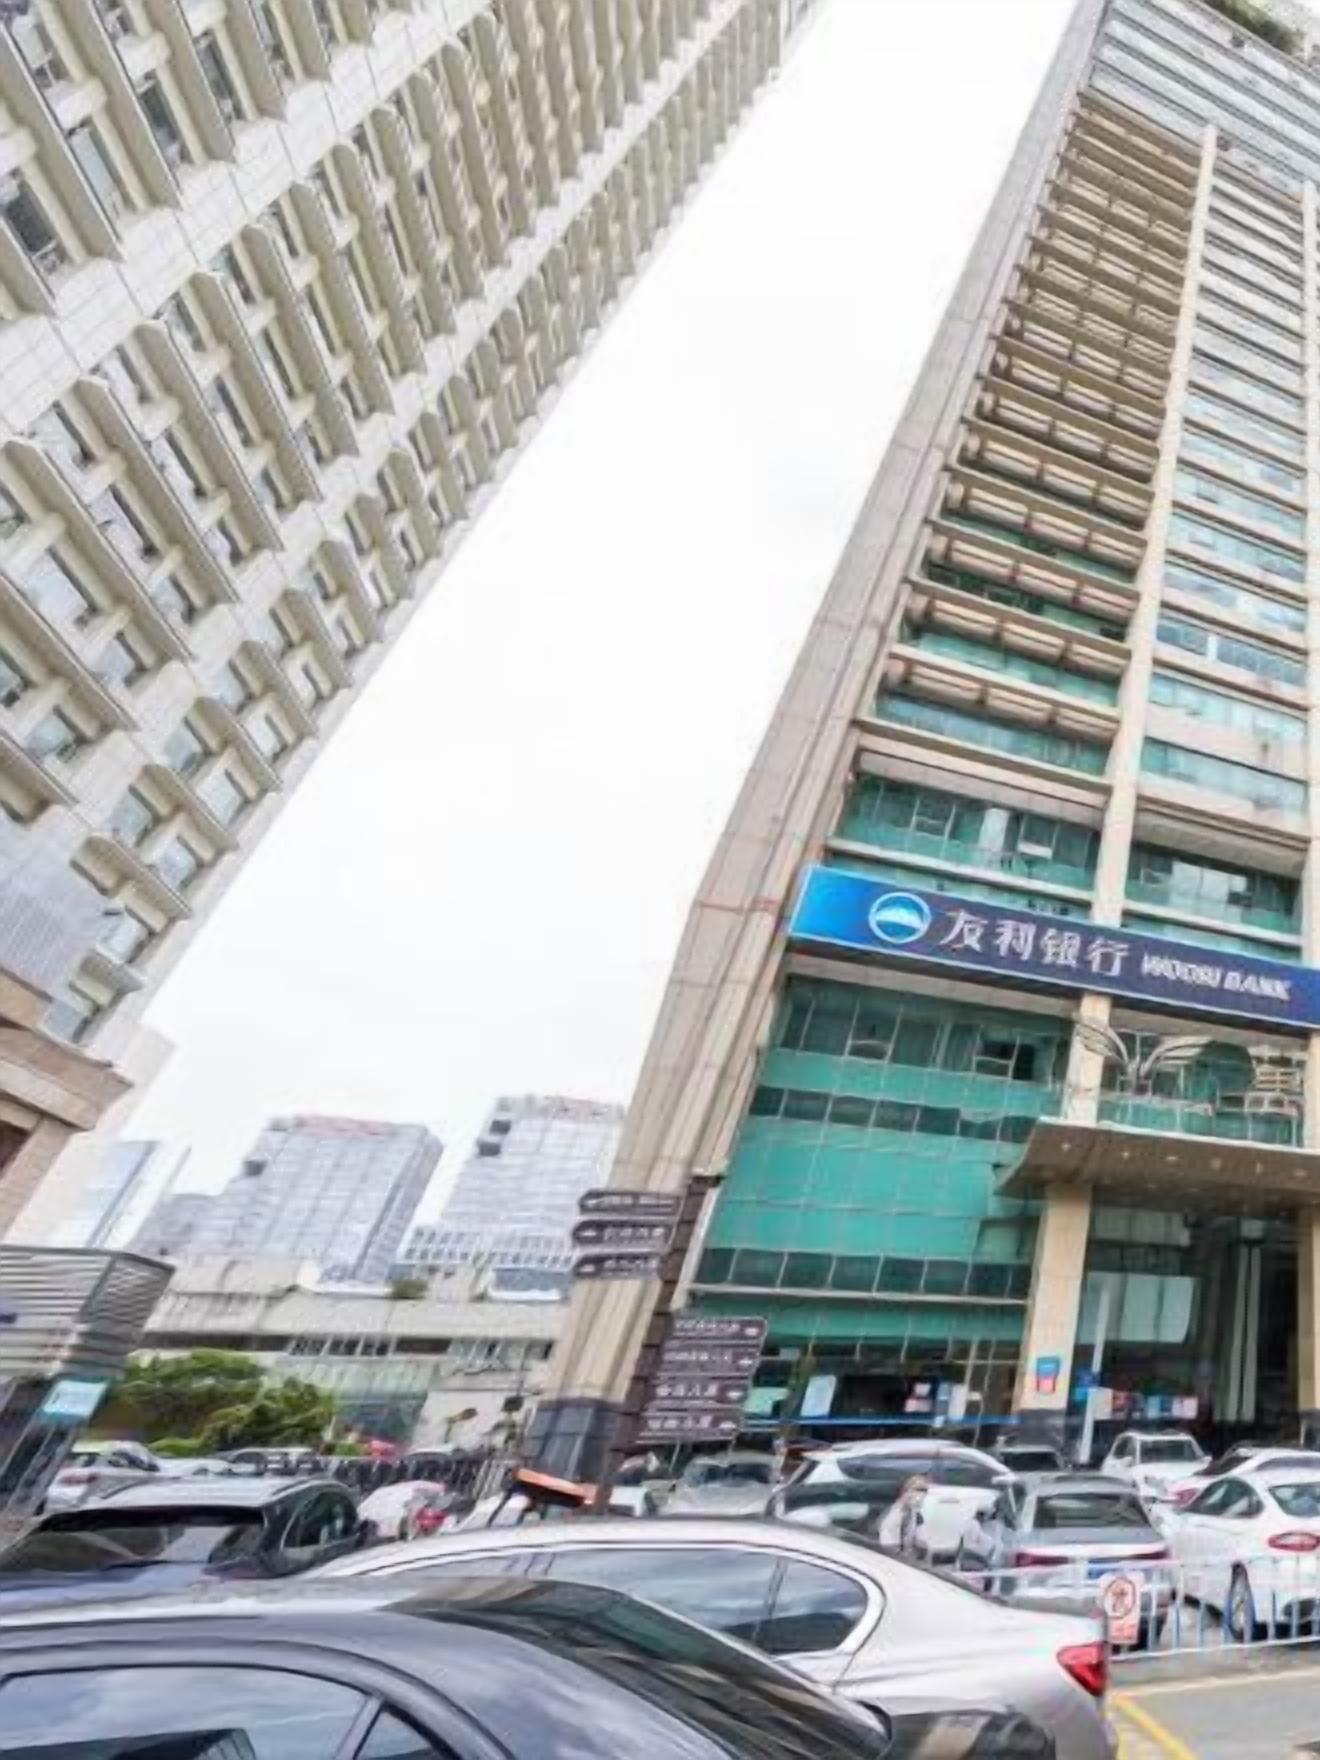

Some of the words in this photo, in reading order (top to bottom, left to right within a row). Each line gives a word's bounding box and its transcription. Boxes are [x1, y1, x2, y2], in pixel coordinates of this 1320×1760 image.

[939, 908, 1130, 978] 友利银行
[1223, 970, 1292, 1002] BANK
